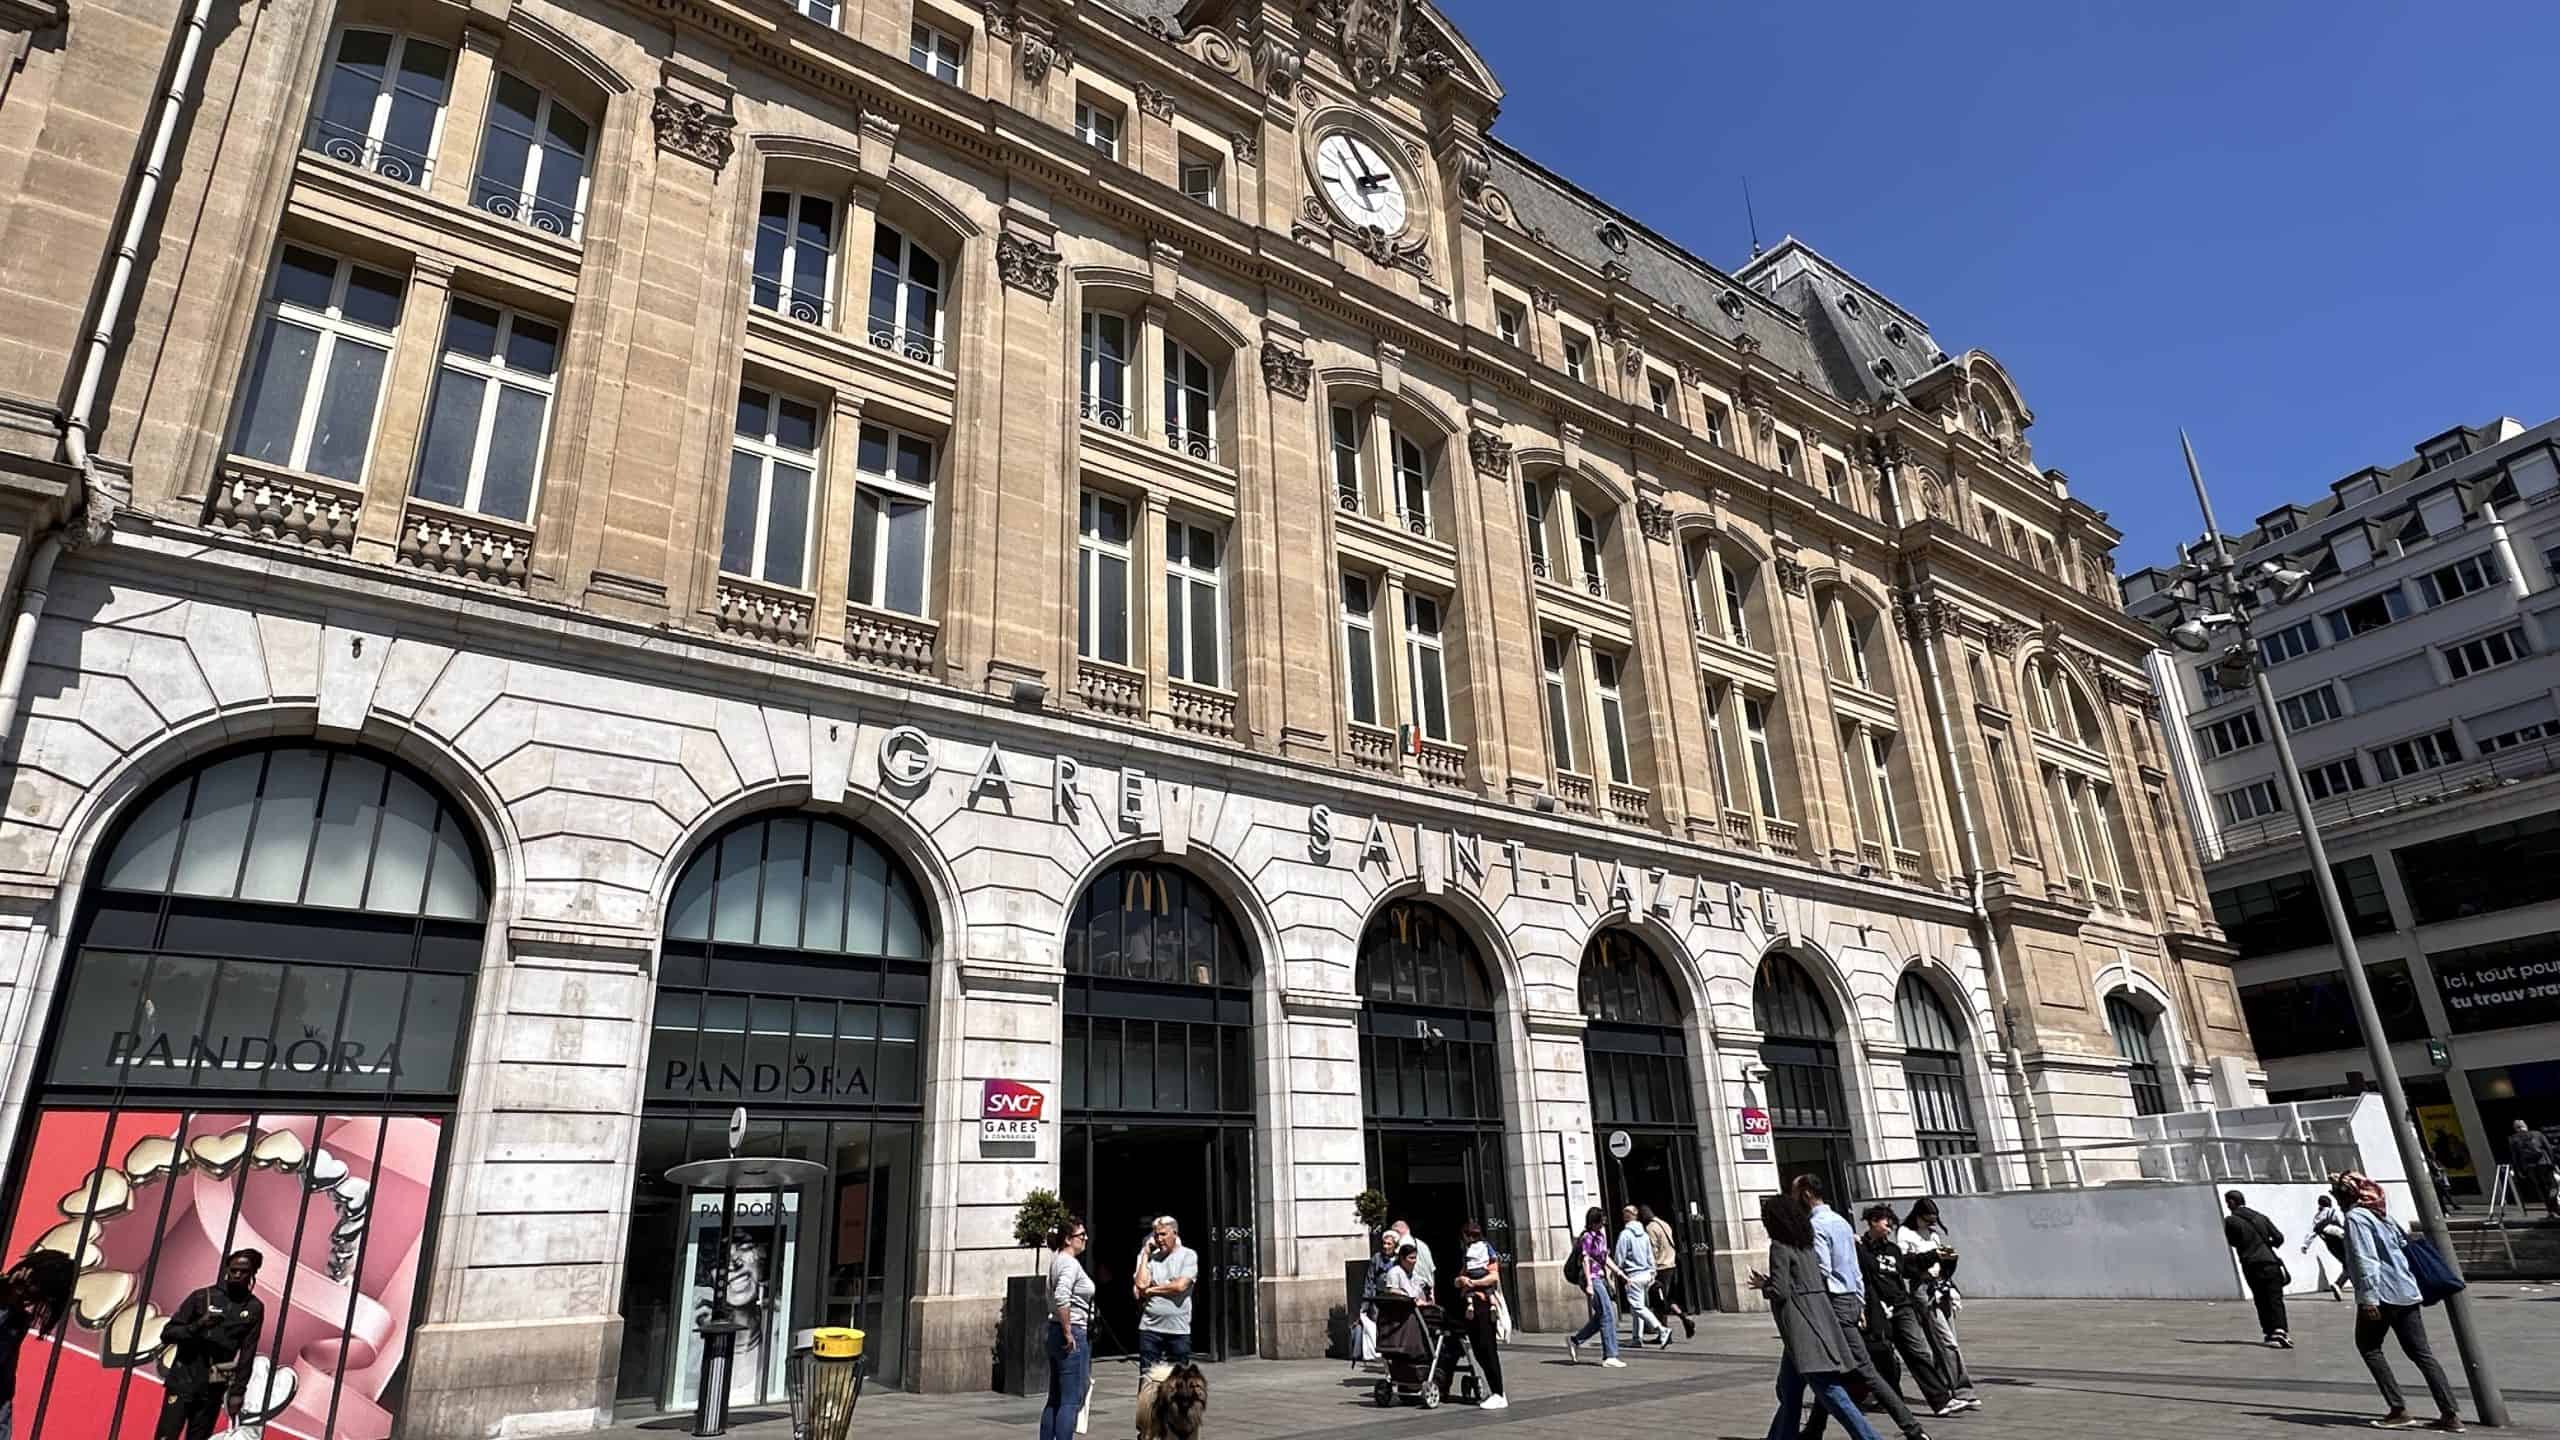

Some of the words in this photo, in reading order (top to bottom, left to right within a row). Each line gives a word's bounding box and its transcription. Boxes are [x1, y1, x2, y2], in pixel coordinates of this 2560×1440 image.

[878, 725, 1147, 821] GARE
[2476, 965, 2517, 983] tout
[2451, 996, 2473, 1009] tu
[2474, 984, 2560, 1005] trouvera
[105, 1031, 404, 1075] PANDORA
[664, 1059, 870, 1095] PANDORA
[987, 1094, 1042, 1113] SNCF
[984, 1121, 1038, 1134] GARES
[700, 1202, 789, 1218] PADORA
